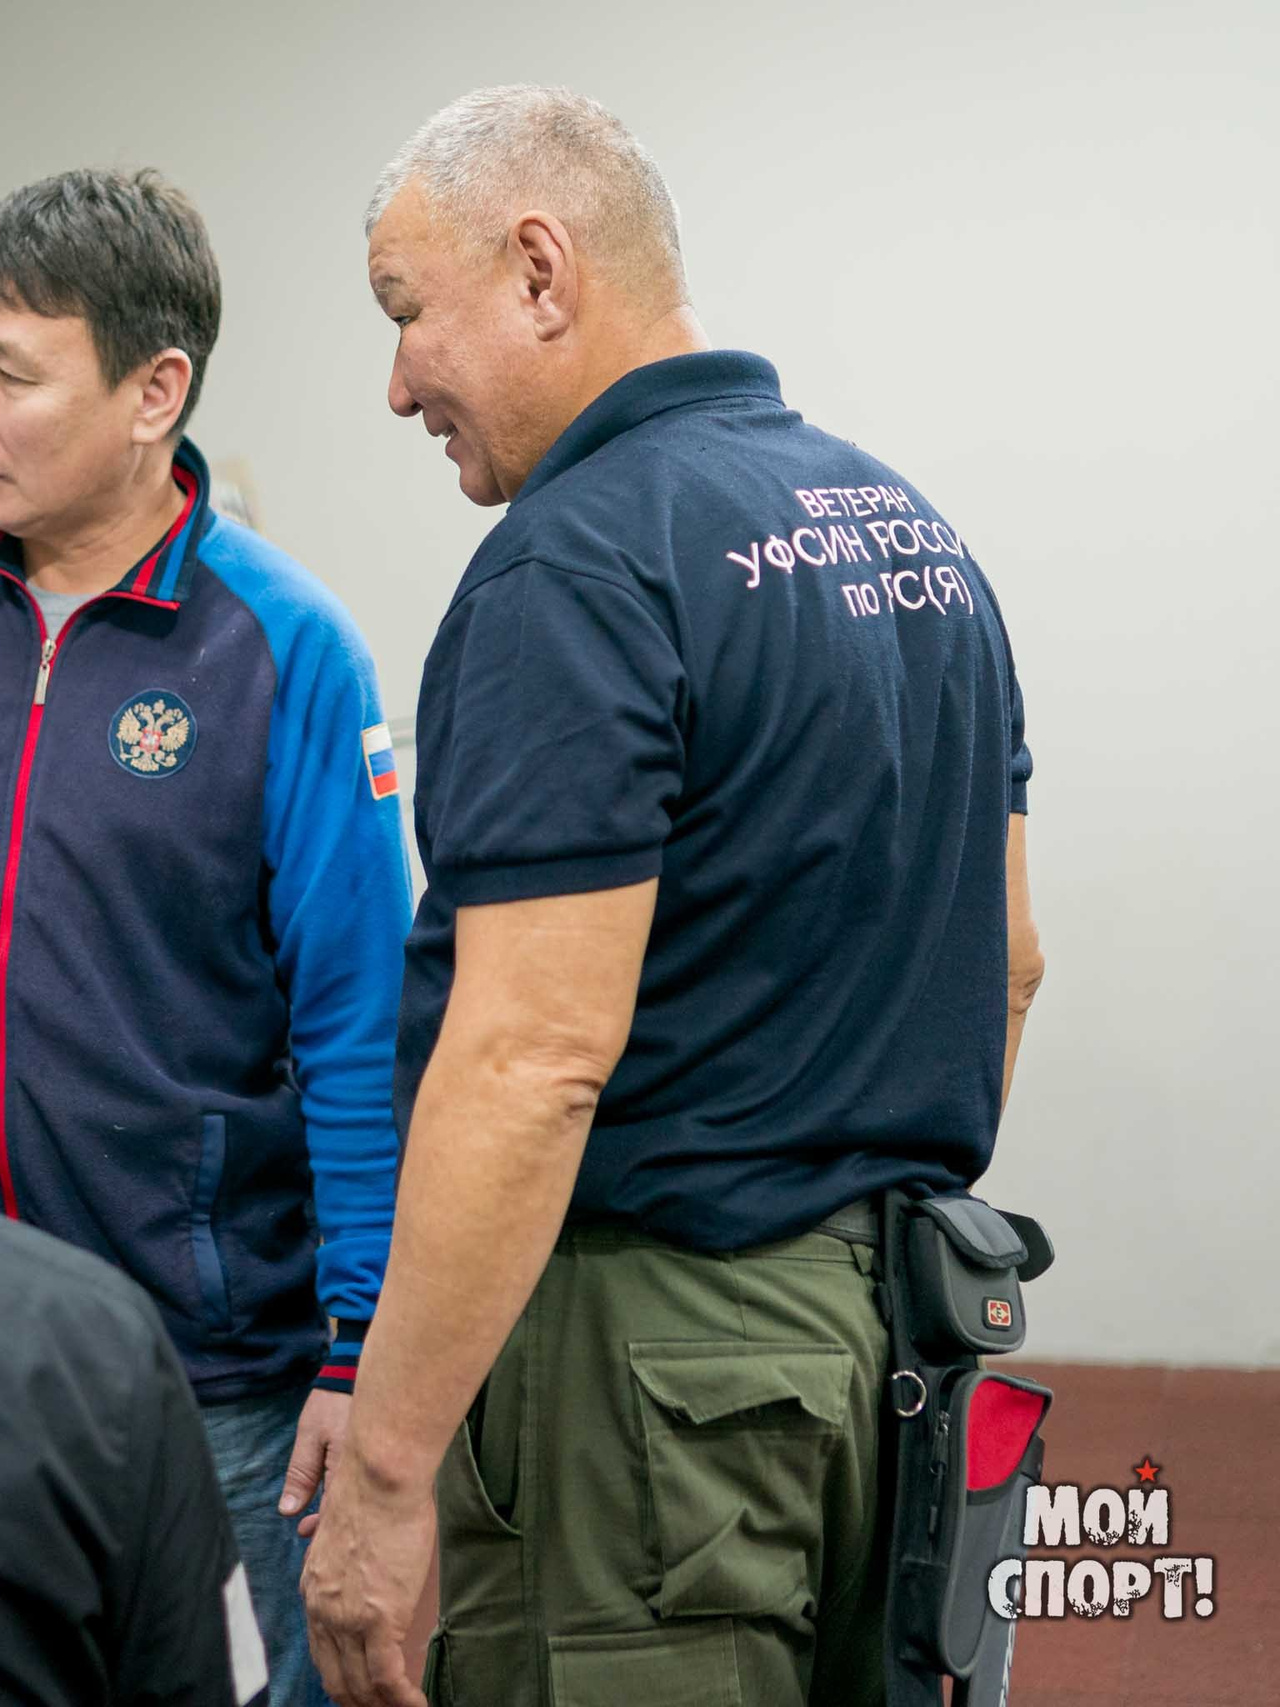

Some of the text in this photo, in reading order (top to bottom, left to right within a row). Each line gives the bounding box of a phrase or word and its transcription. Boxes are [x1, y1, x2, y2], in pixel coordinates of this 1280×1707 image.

[796, 485, 916, 518] ВЕТЕРАН
[726, 519, 975, 589] УФСИН РОССИ
